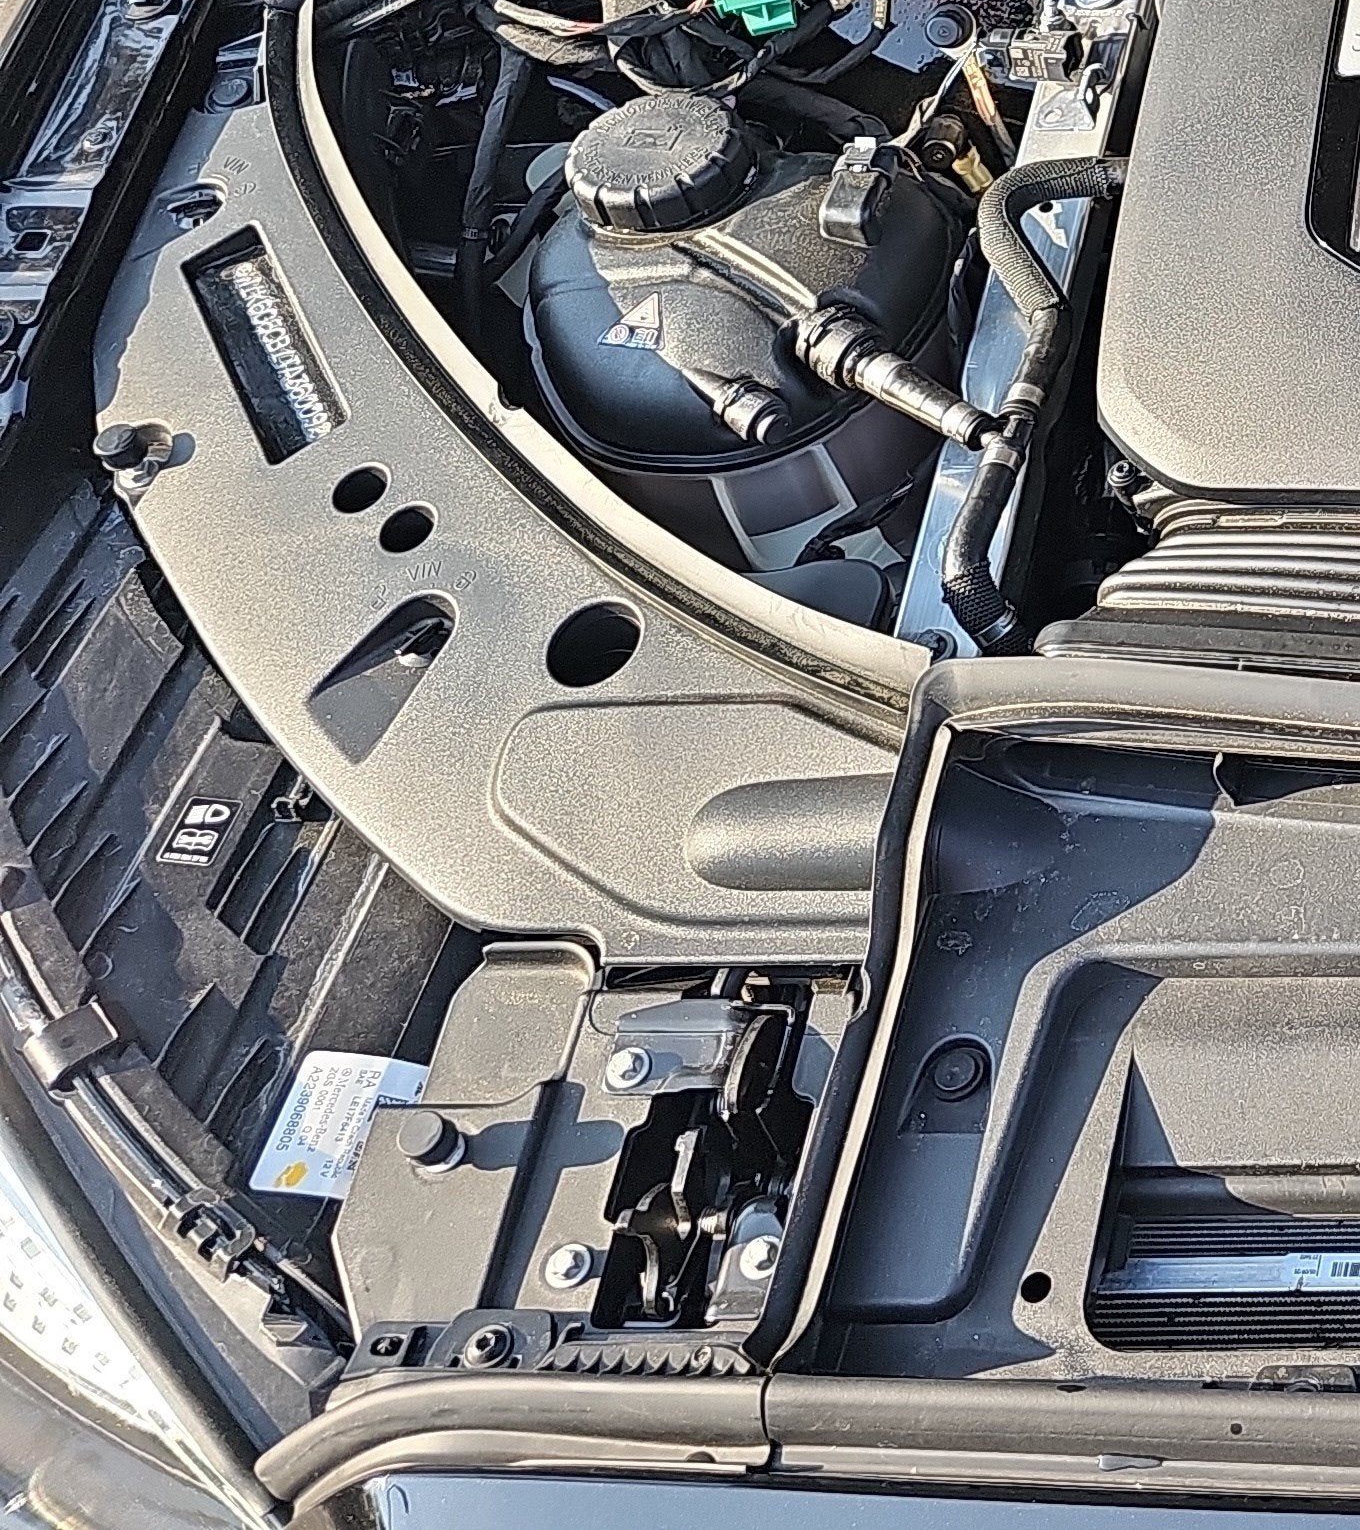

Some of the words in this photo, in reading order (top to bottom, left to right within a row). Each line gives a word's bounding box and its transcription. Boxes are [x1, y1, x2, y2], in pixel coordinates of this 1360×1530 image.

[223, 156, 250, 174] VIN
[407, 561, 442, 581] VIN
[363, 1070, 381, 1089] RA
[275, 1065, 324, 1151] A2239068805
[307, 1078, 346, 1152] Mercedes-Benz
